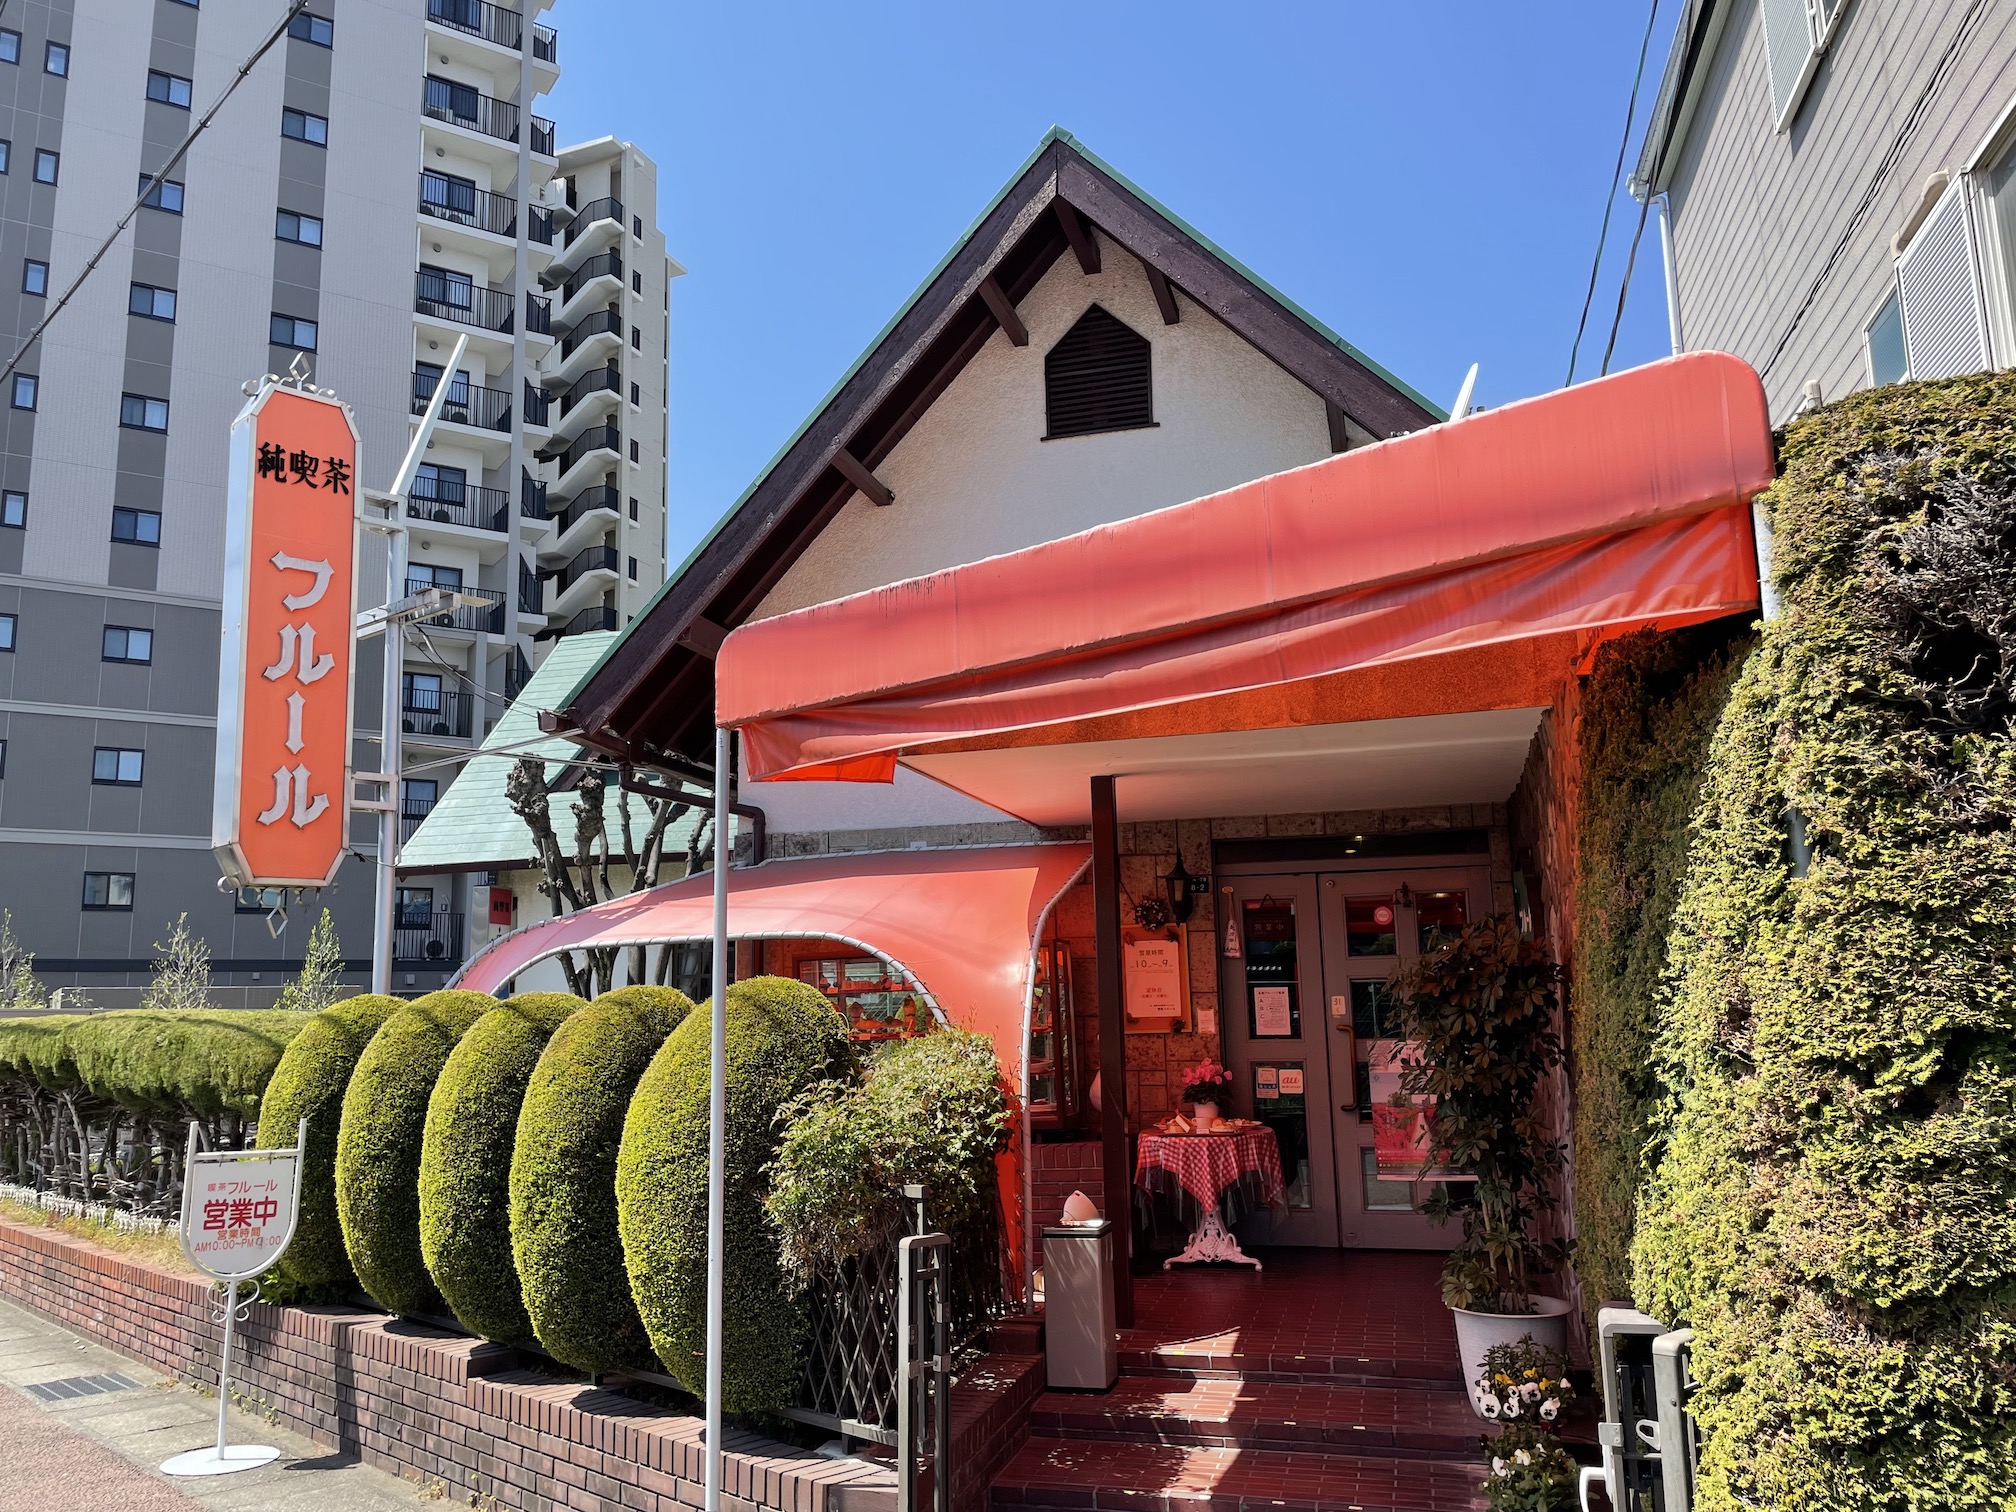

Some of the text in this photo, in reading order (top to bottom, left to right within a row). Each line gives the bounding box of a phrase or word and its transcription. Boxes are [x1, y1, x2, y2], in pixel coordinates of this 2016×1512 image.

[257, 441, 351, 495] 純喫茶
[256, 550, 336, 830] フルール
[1282, 1076, 1300, 1084] au
[203, 1195, 278, 1230] 営業中
[217, 1227, 261, 1240] 営業時間
